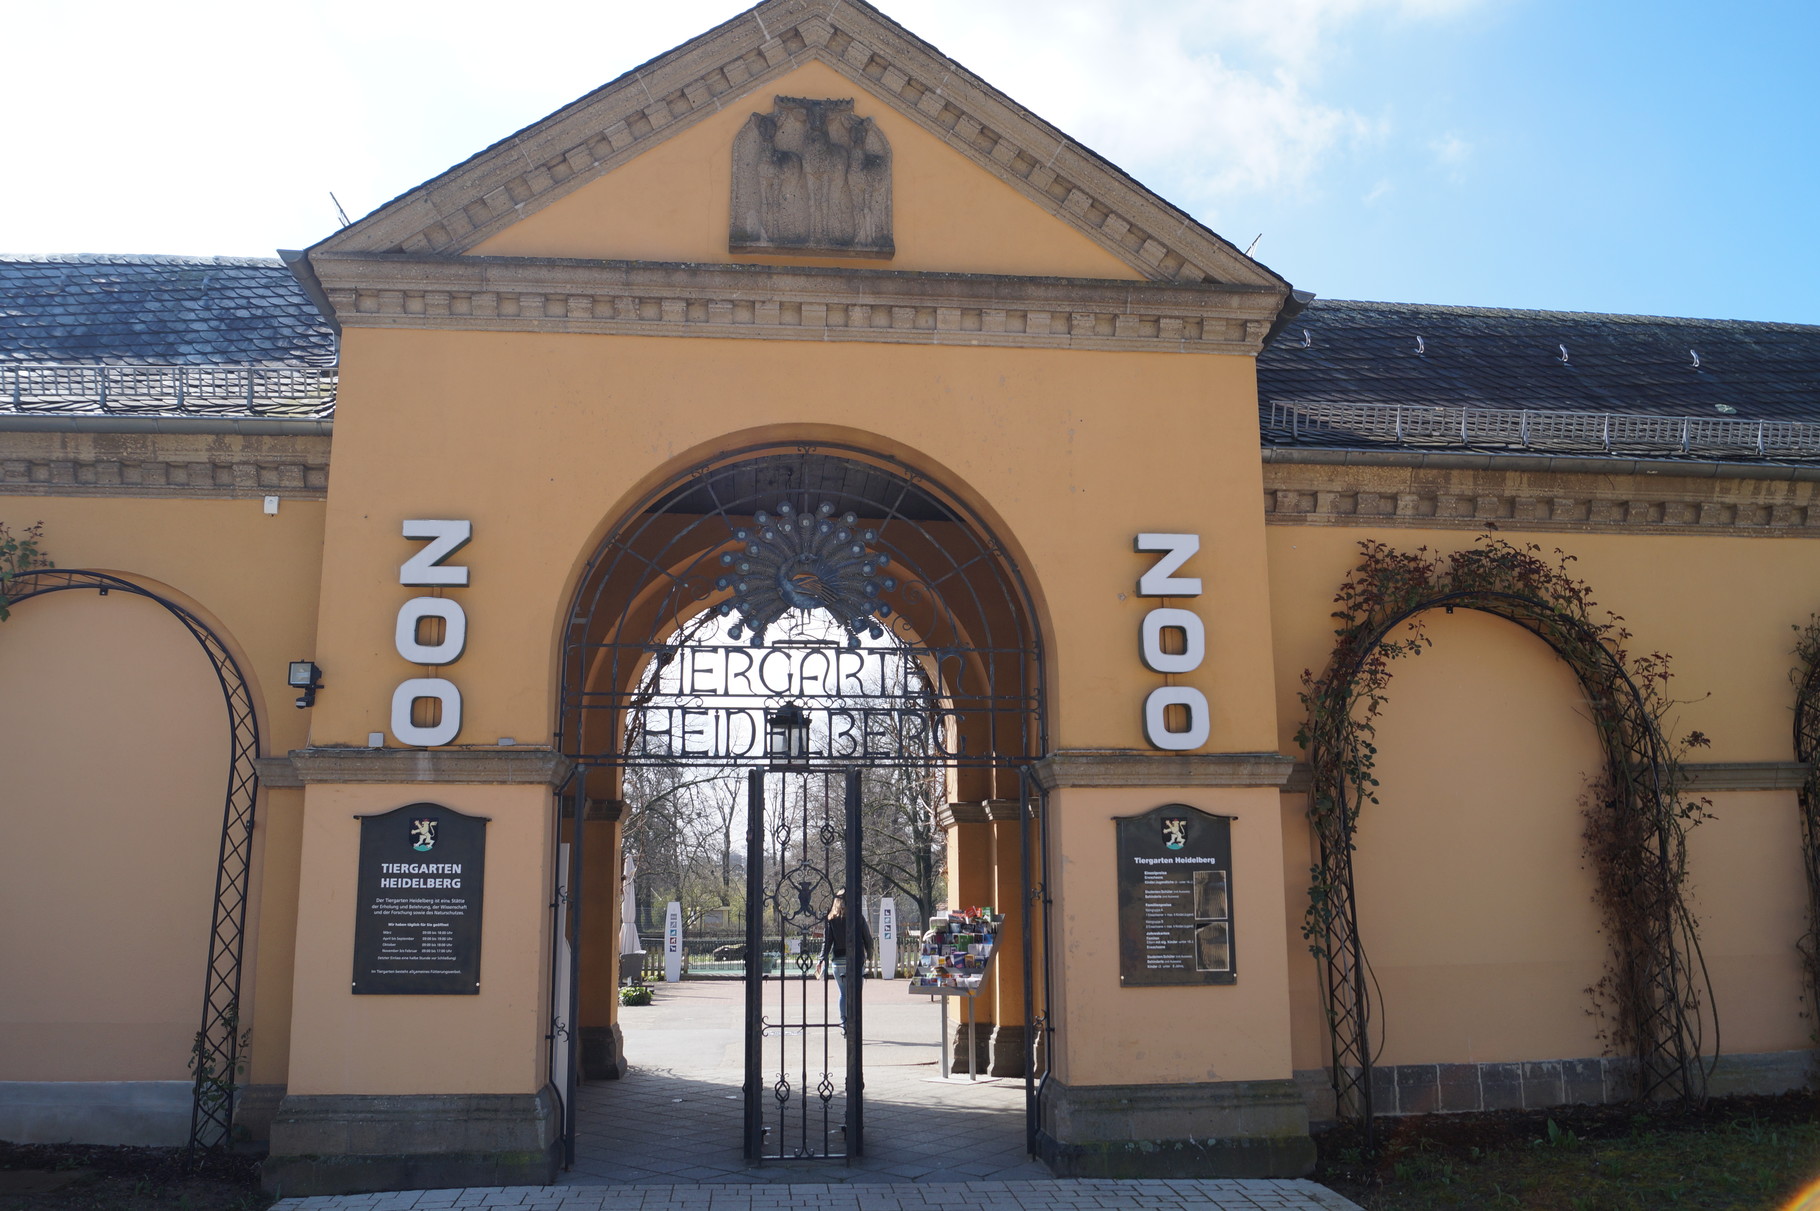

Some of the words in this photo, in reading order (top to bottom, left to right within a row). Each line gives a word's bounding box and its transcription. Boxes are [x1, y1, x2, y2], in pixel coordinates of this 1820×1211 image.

[391, 519, 472, 747] ZOO
[1134, 533, 1211, 751] ZOO
[644, 648, 968, 697] TIERGARTEN
[642, 707, 969, 758] HEIDELBERG
[380, 878, 461, 889] HEIDELBERG
[381, 863, 462, 874] TIERGARTEN
[1134, 857, 1173, 865] Tiergarten
